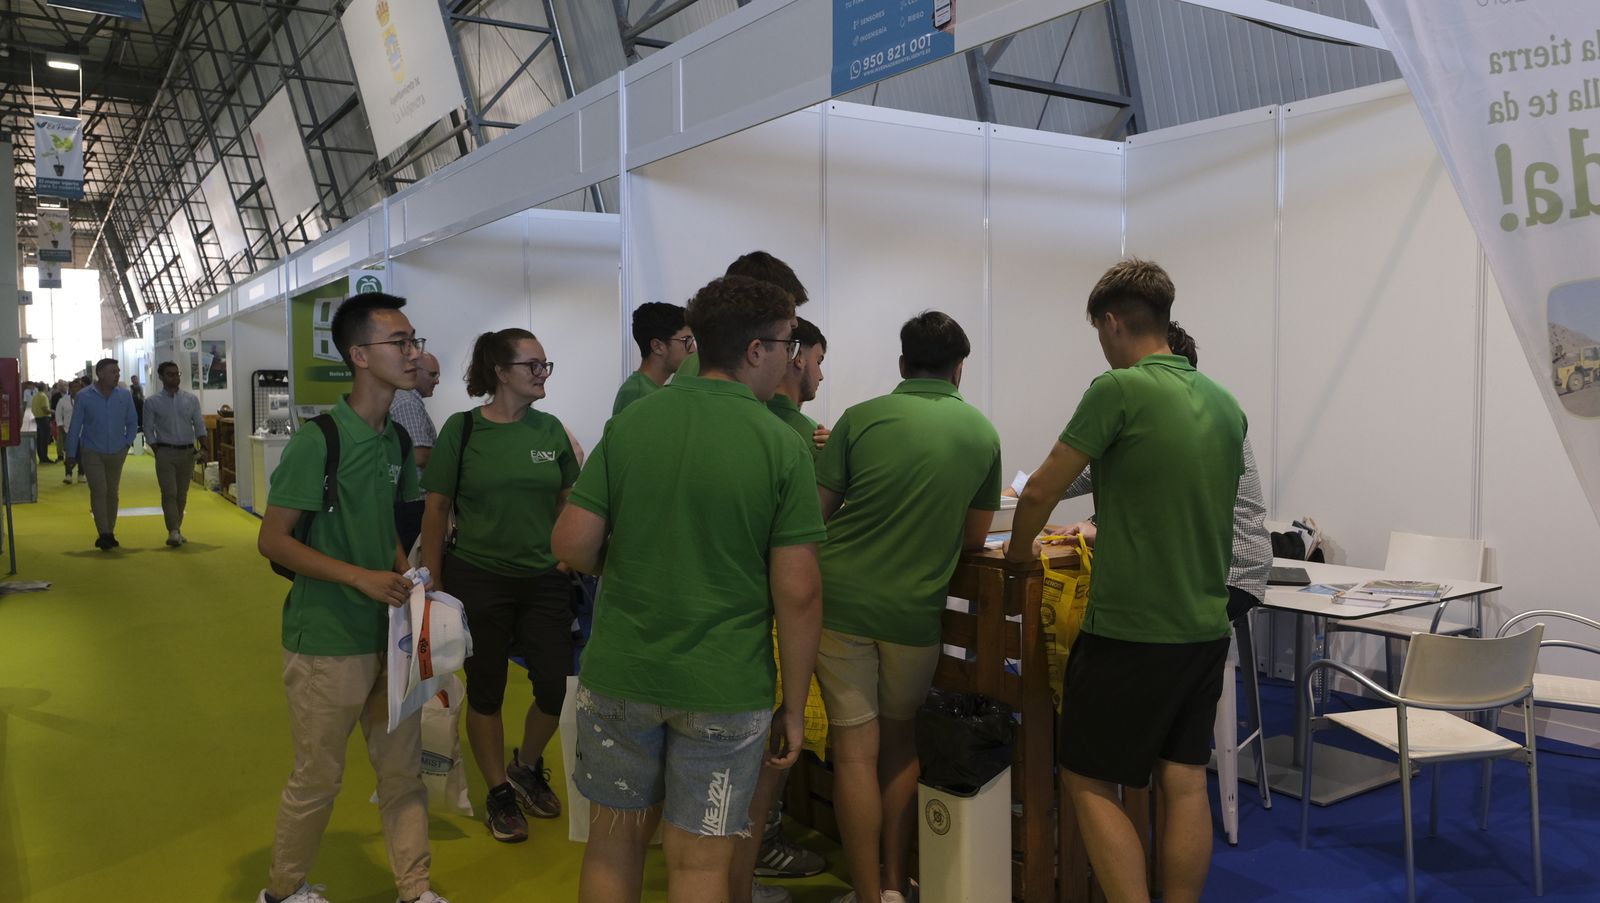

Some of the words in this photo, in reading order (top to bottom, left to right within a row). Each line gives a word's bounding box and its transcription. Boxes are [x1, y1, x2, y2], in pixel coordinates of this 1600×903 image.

[860, 9, 885, 25] SENSORES
[908, 10, 924, 22] RIEGO
[863, 52, 884, 70] 950
[887, 43, 906, 61] 821
[909, 33, 931, 52] 001
